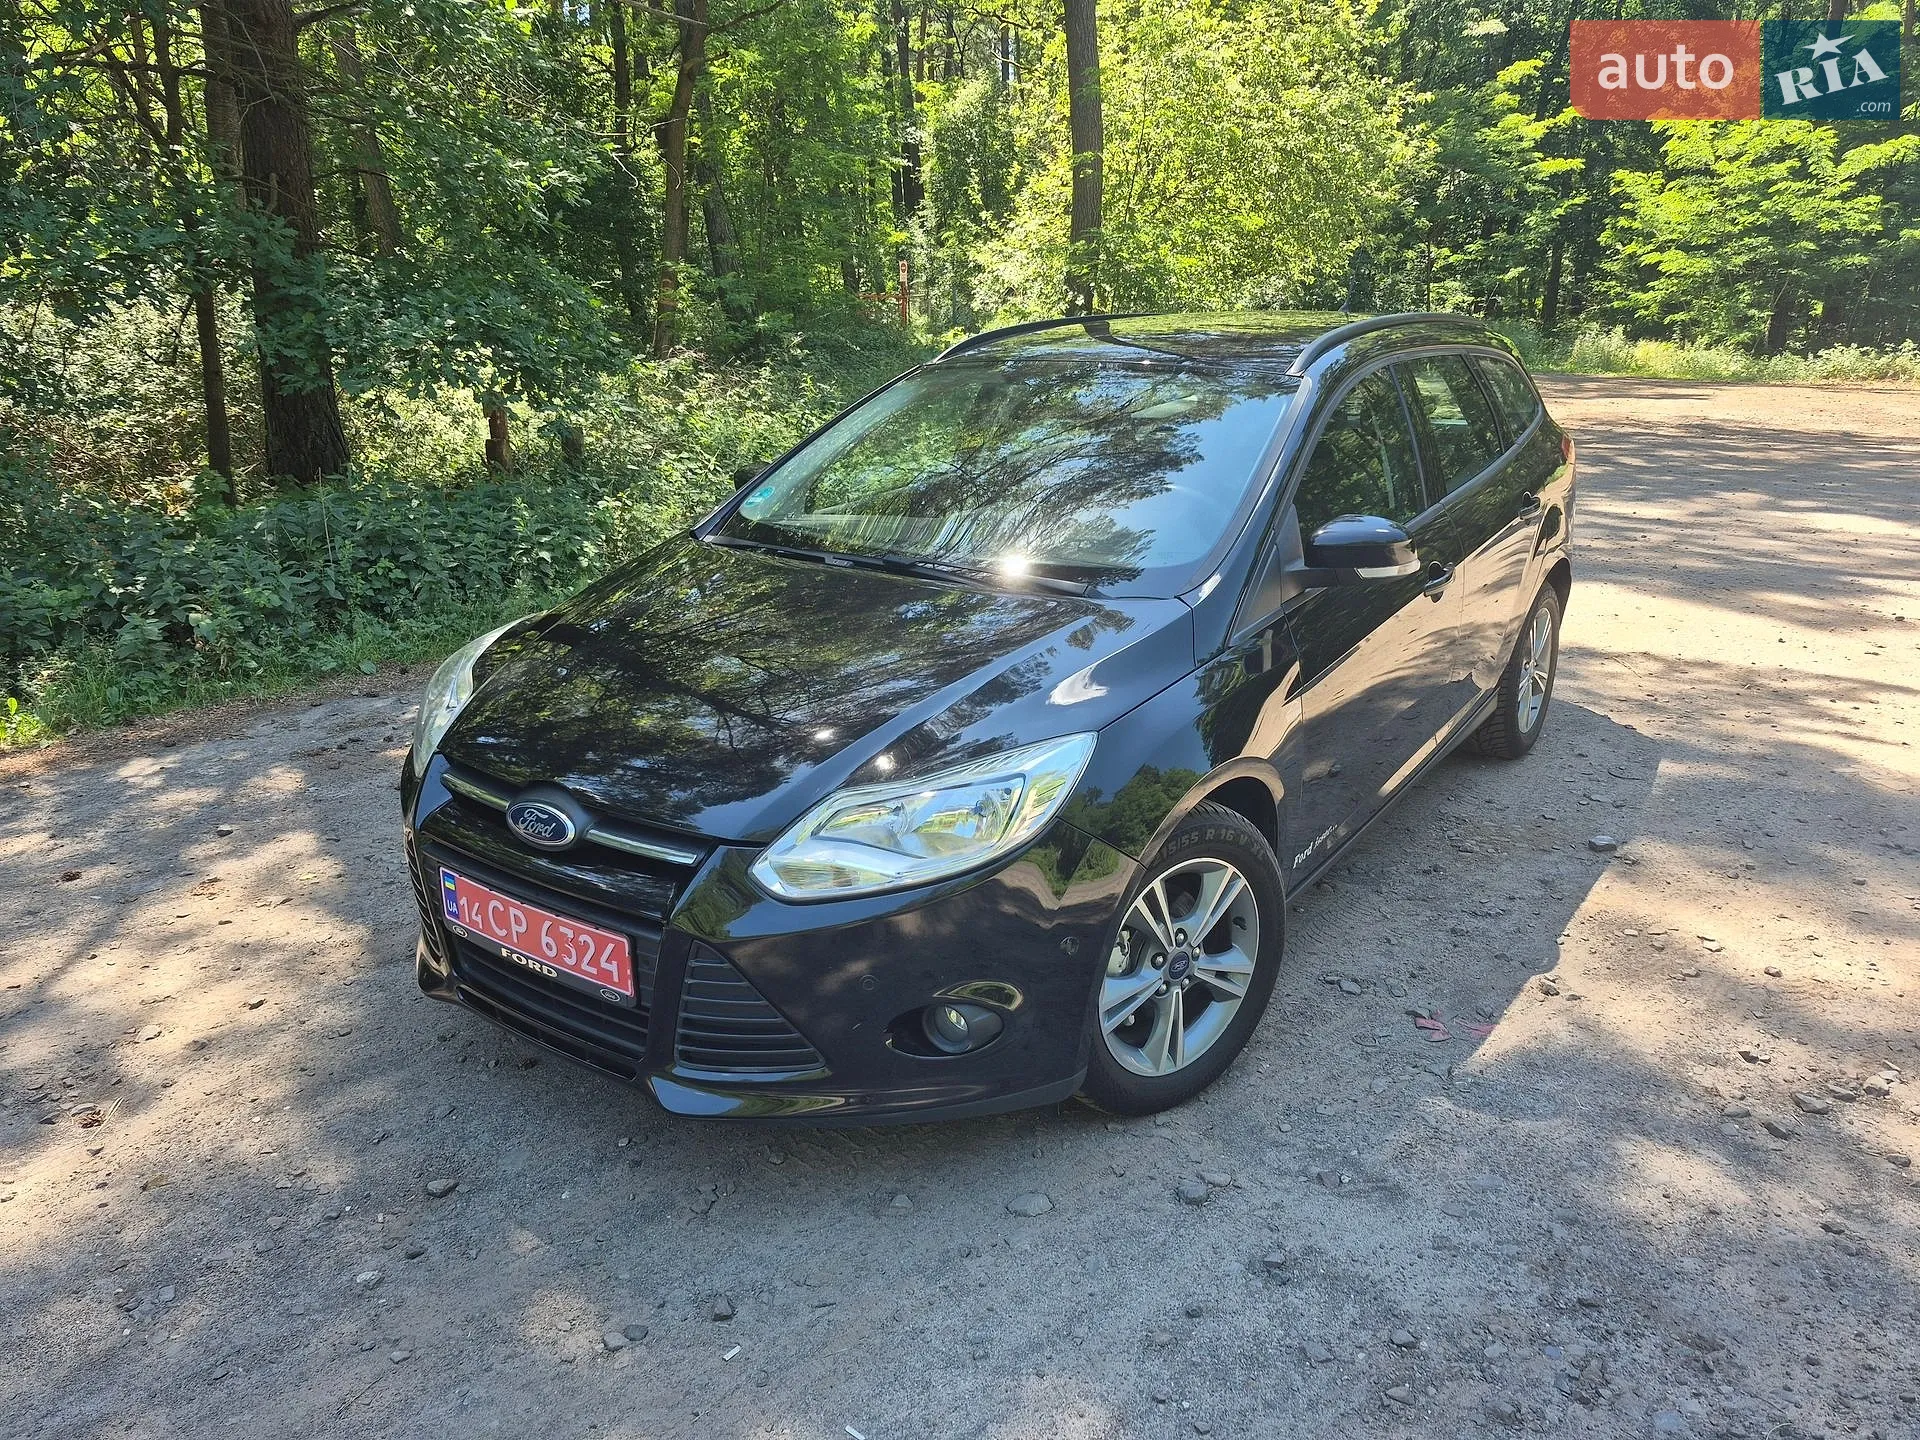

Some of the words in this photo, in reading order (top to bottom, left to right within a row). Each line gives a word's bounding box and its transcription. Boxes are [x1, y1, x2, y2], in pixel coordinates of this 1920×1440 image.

[518, 808, 557, 839] Ford
[447, 899, 459, 915] UA
[501, 947, 558, 978] FORD
[540, 921, 619, 983] 6324
